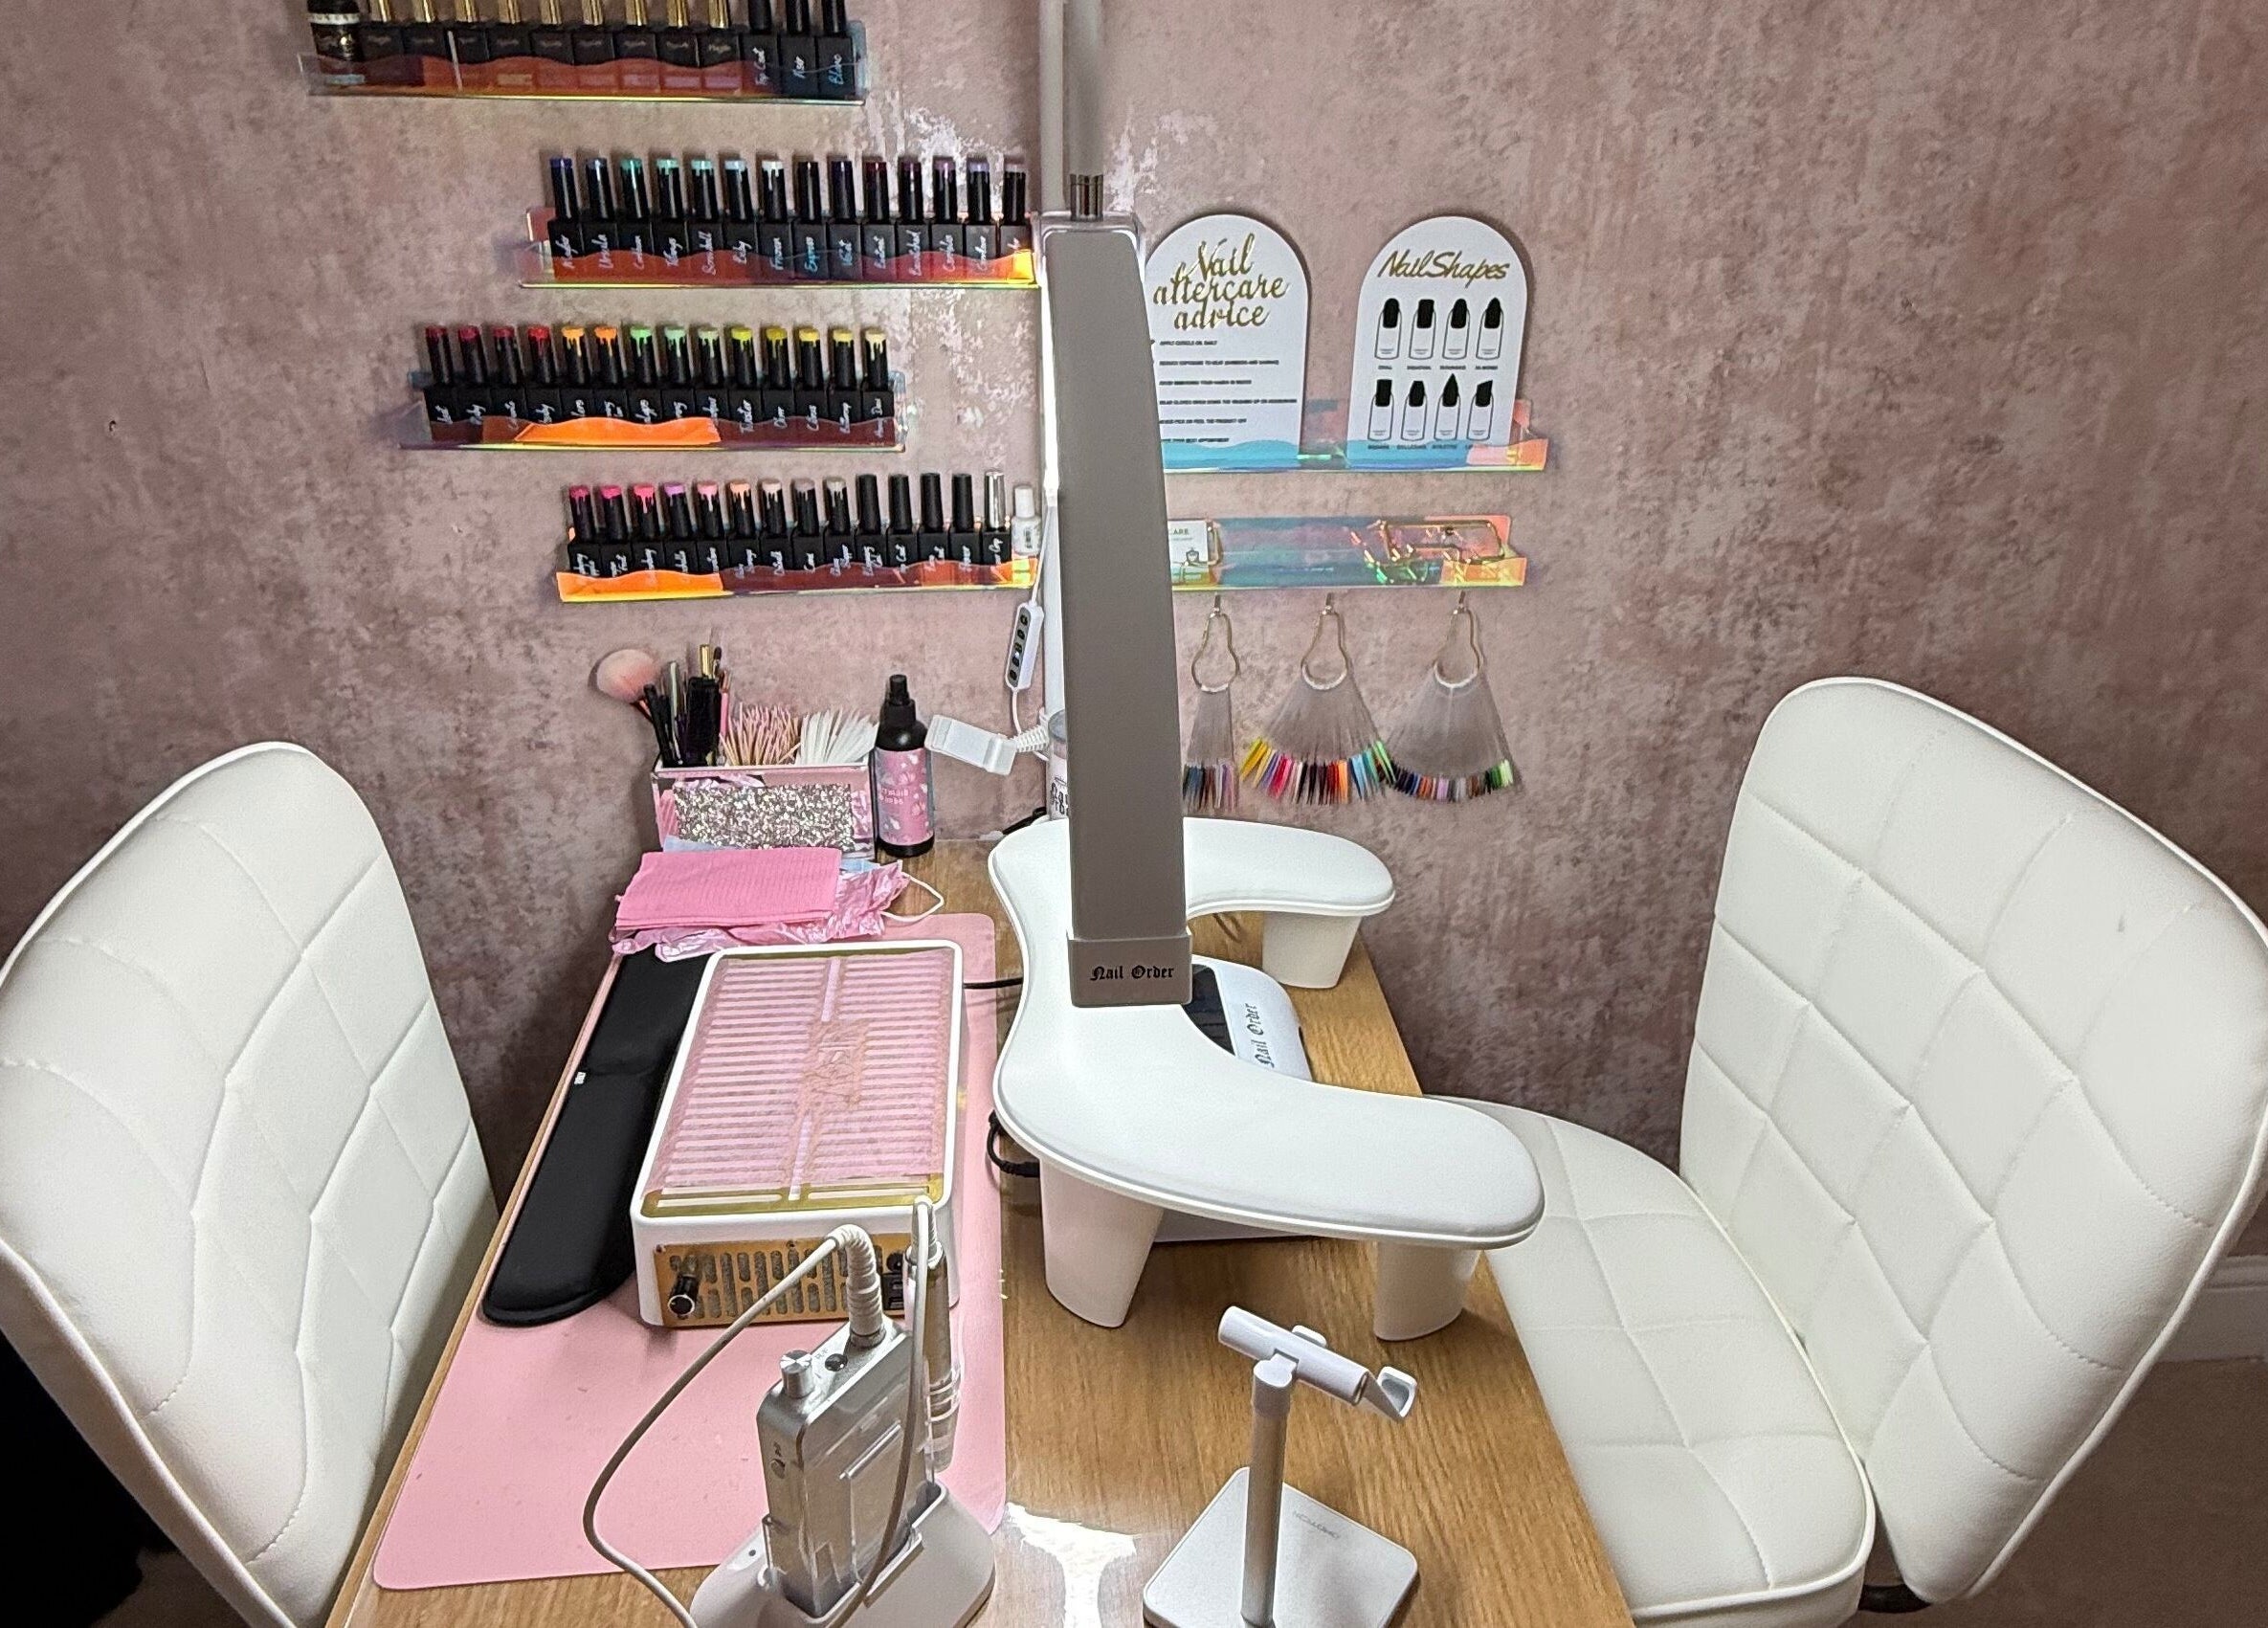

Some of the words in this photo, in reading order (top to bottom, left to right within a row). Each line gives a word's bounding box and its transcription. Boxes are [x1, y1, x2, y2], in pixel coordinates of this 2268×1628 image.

[1188, 233, 1256, 282] Nail
[1153, 262, 1290, 305] aftercare
[1174, 297, 1270, 330] advice
[1090, 965, 1124, 981] Nail
[1131, 965, 1175, 980] Order
[1245, 1003, 1264, 1036] Order
[1250, 1040, 1275, 1068] Nail
